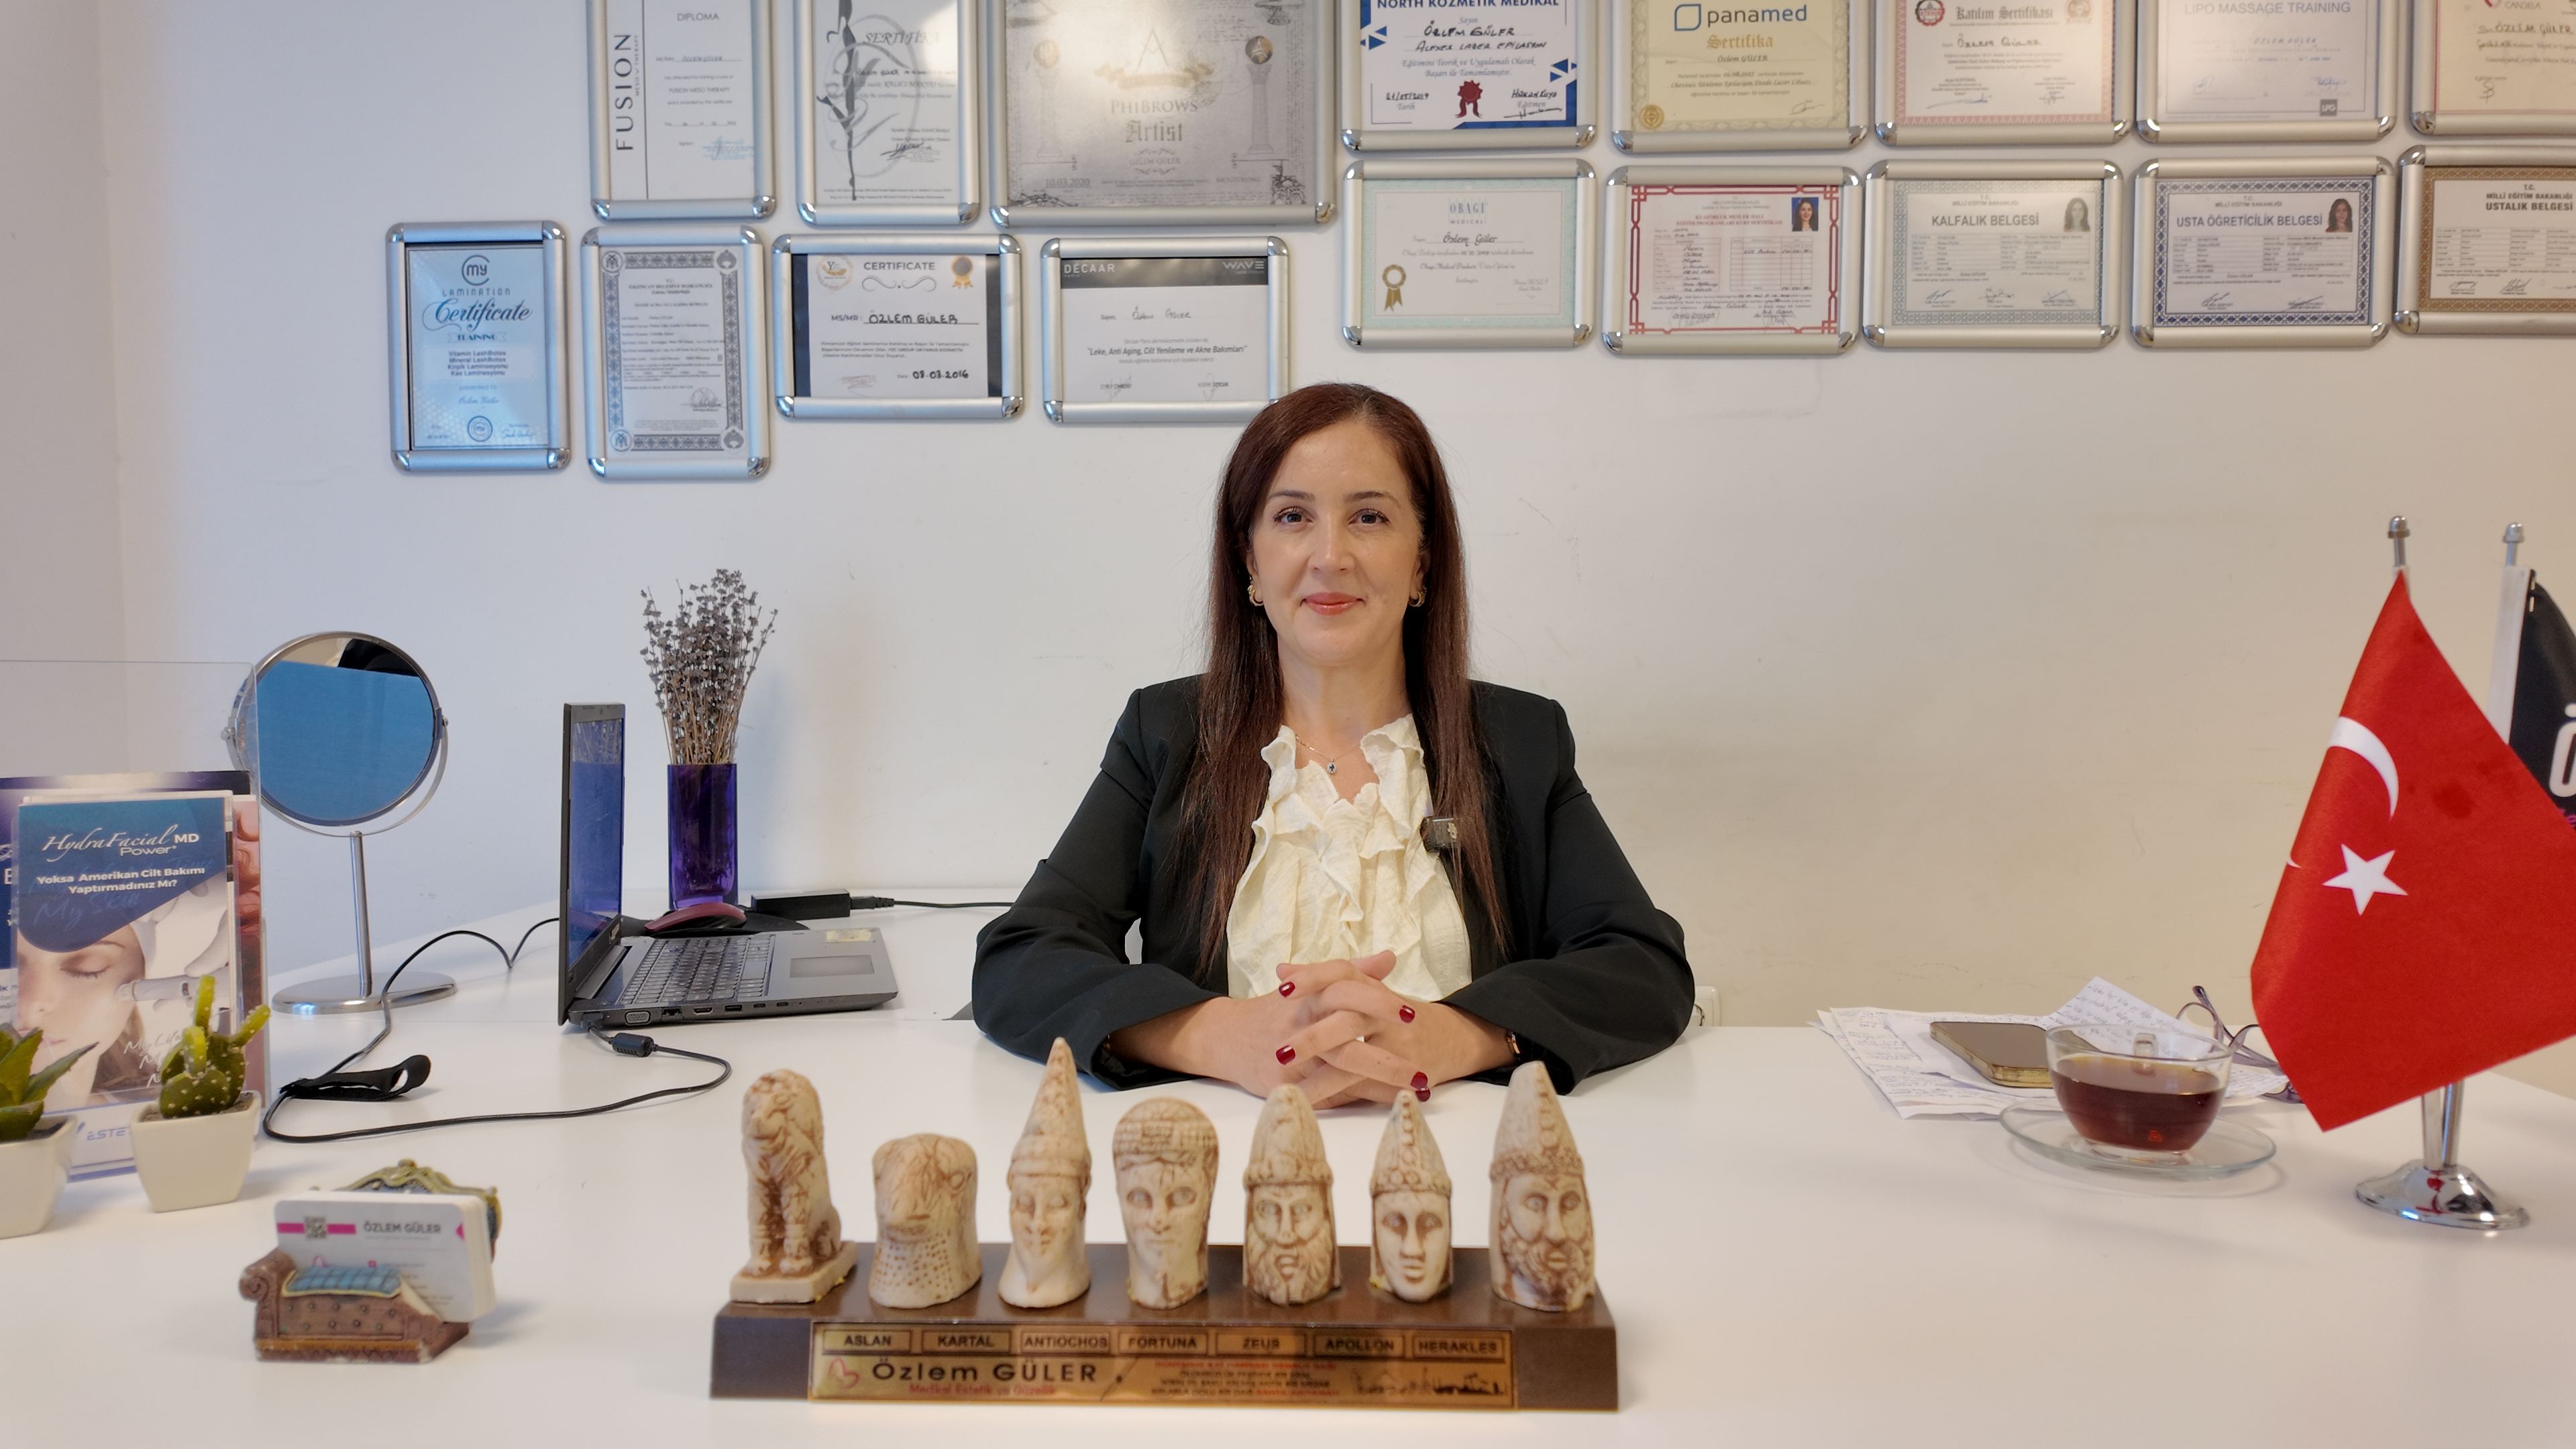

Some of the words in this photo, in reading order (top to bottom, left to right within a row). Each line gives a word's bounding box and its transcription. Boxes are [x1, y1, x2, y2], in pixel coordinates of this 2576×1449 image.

[1955, 6, 1994, 21] Katılım
[2184, 4, 2214, 14] LIPO
[2218, 3, 2284, 14] MASSAGE
[2288, 1, 2351, 13] TRAINING
[677, 13, 720, 21] DIPLOMA
[1707, 5, 1807, 28] panamed
[1706, 34, 1774, 50] Sertifika
[614, 34, 634, 151] FUSION
[1125, 120, 1183, 142] Artist
[1045, 178, 1091, 187] 10.03.2020
[2486, 203, 2528, 211] USTALIK
[2530, 201, 2573, 211] BELGESİ
[1931, 215, 1987, 227] KALFALIK
[1990, 212, 2039, 226] BELGESİ
[2176, 216, 2204, 227] USTA
[2206, 214, 2274, 227] ÖĞRETİCİLİK
[2277, 213, 2322, 226] BELGESİ
[863, 262, 936, 270] CERTIFICATE
[1063, 262, 1116, 274] DÉCAAR
[441, 288, 511, 298] LAMINATION
[425, 297, 534, 333] Certificate
[868, 310, 912, 324] ÖZLEM
[916, 312, 959, 325] GÜLER
[42, 824, 178, 863] HydraFacial
[174, 833, 200, 843] MD
[36, 875, 74, 885] Yoksa
[78, 871, 140, 881] Amerikan
[140, 869, 162, 878] Cilt
[163, 867, 205, 877] Bakımı
[68, 882, 156, 896] Yaptırmadınız
[157, 879, 178, 888] Mı?
[86, 1126, 129, 1141] ESTE
[363, 1220, 402, 1233] ÖZLEM
[404, 1221, 442, 1234] GÜLER
[843, 1334, 893, 1347] ASLAN
[938, 1334, 994, 1348] KARTAL
[1024, 1334, 1108, 1349] ANTIOCHOS
[1128, 1335, 1197, 1350] FORTUNA
[1242, 1336, 1281, 1350] ZEUS
[1325, 1337, 1395, 1351] APOLLON
[1417, 1340, 1498, 1355] HERAKLES
[872, 1357, 978, 1382] Özlem
[992, 1356, 1097, 1382] GÜLER
